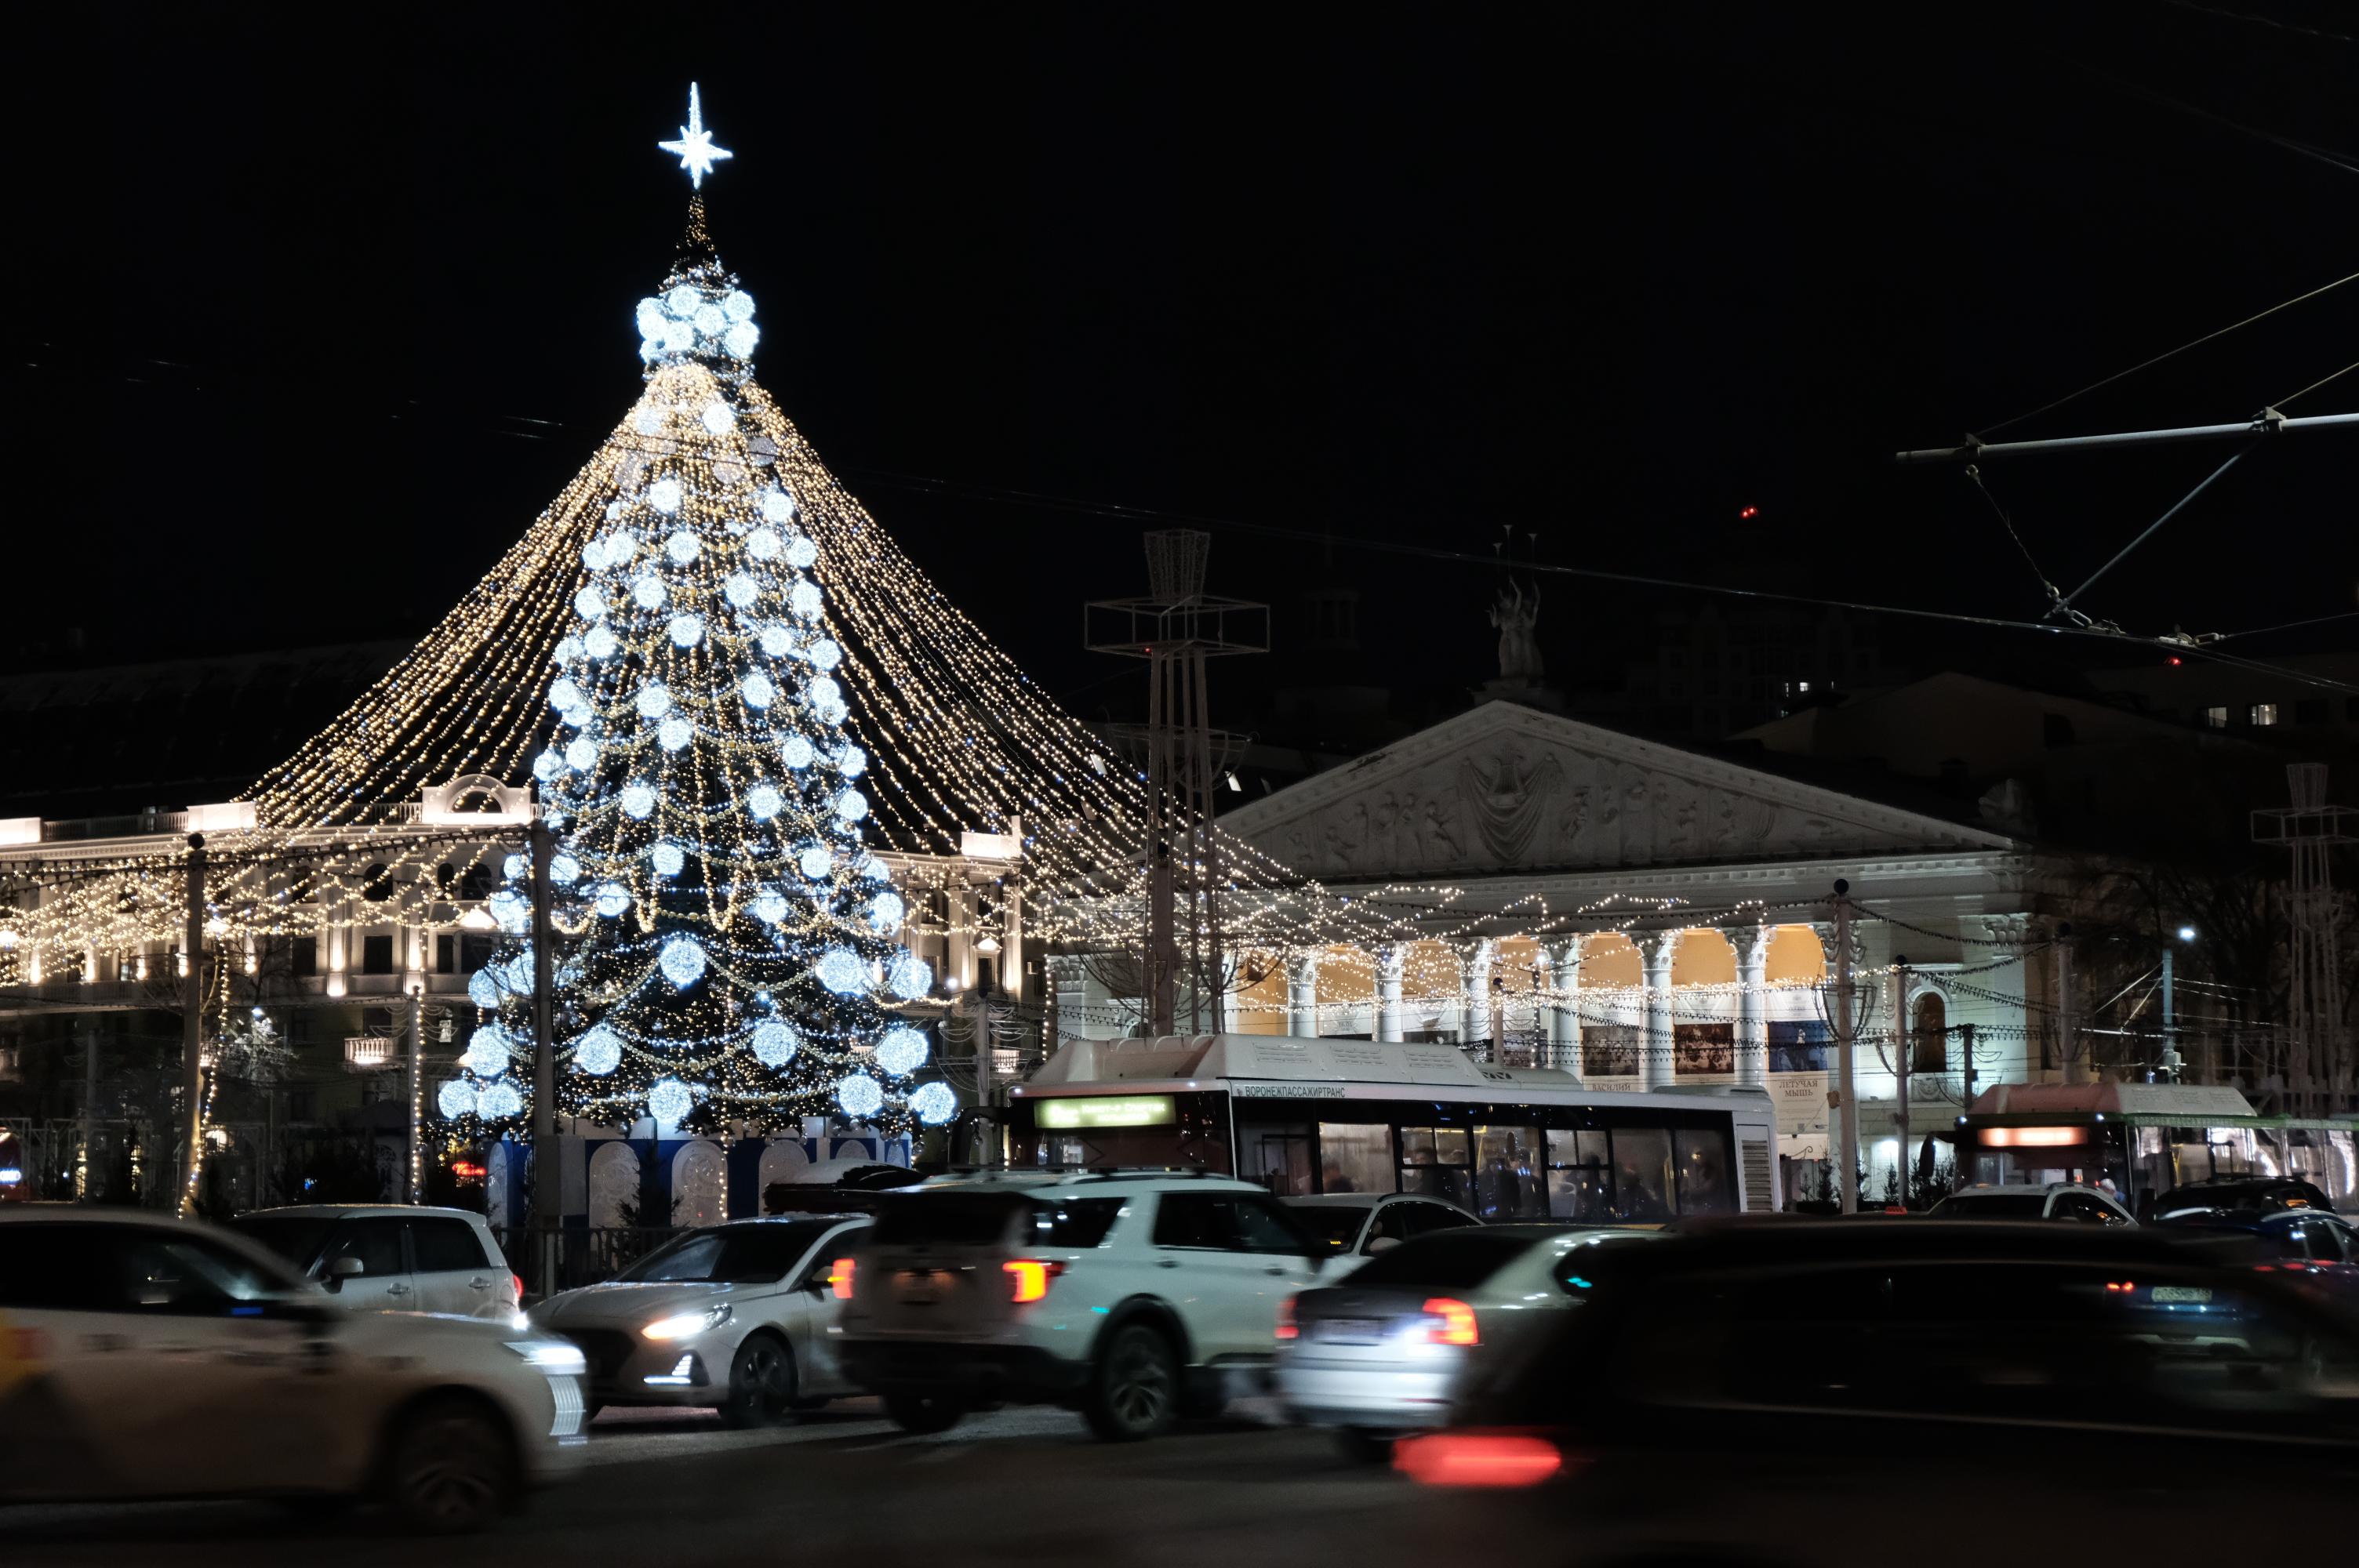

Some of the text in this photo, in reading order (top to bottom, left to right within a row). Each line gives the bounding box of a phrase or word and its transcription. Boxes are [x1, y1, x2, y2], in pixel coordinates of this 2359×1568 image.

[1779, 1080, 1818, 1089] ЛЕТУЧАЯ
[1245, 1086, 1346, 1098] ВОРОНЕЖПАССАЖИРТРАНС
[1784, 1089, 1814, 1098] МЫШЬ
